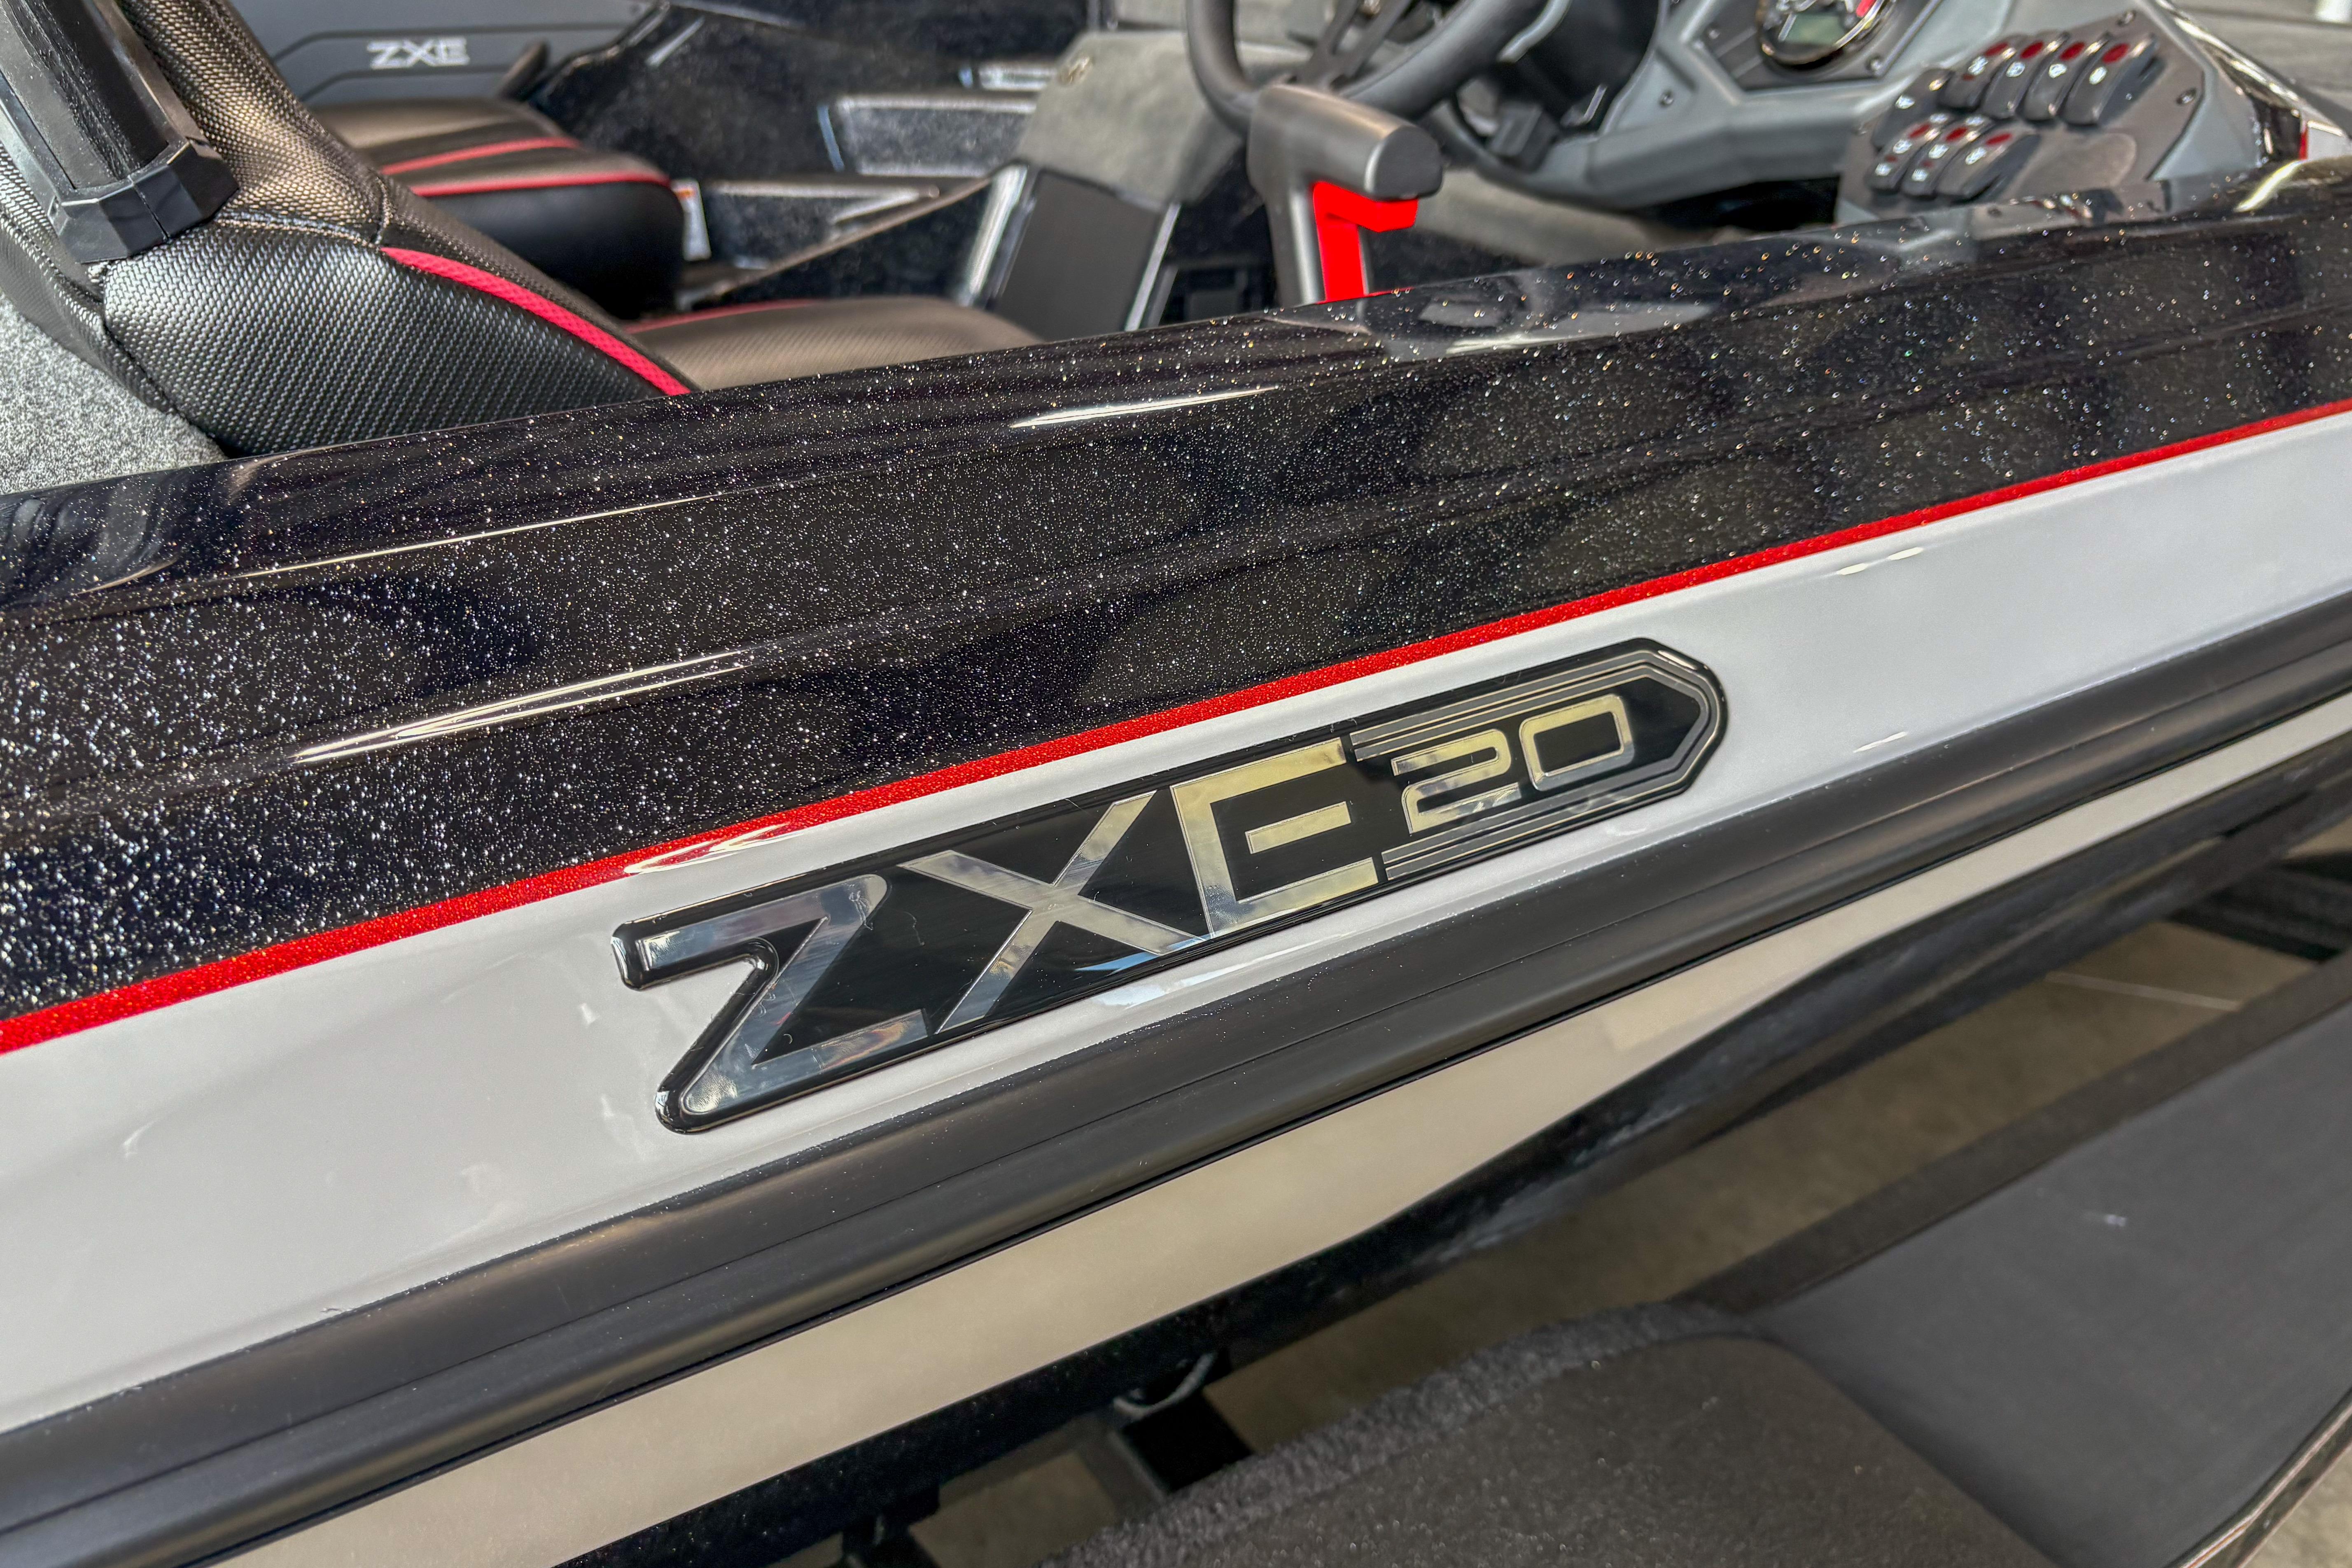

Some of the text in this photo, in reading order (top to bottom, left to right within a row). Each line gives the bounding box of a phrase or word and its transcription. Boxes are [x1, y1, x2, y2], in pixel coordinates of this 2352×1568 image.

[366, 36, 470, 70] ZXE
[636, 694, 1635, 1115] ZXE 20
